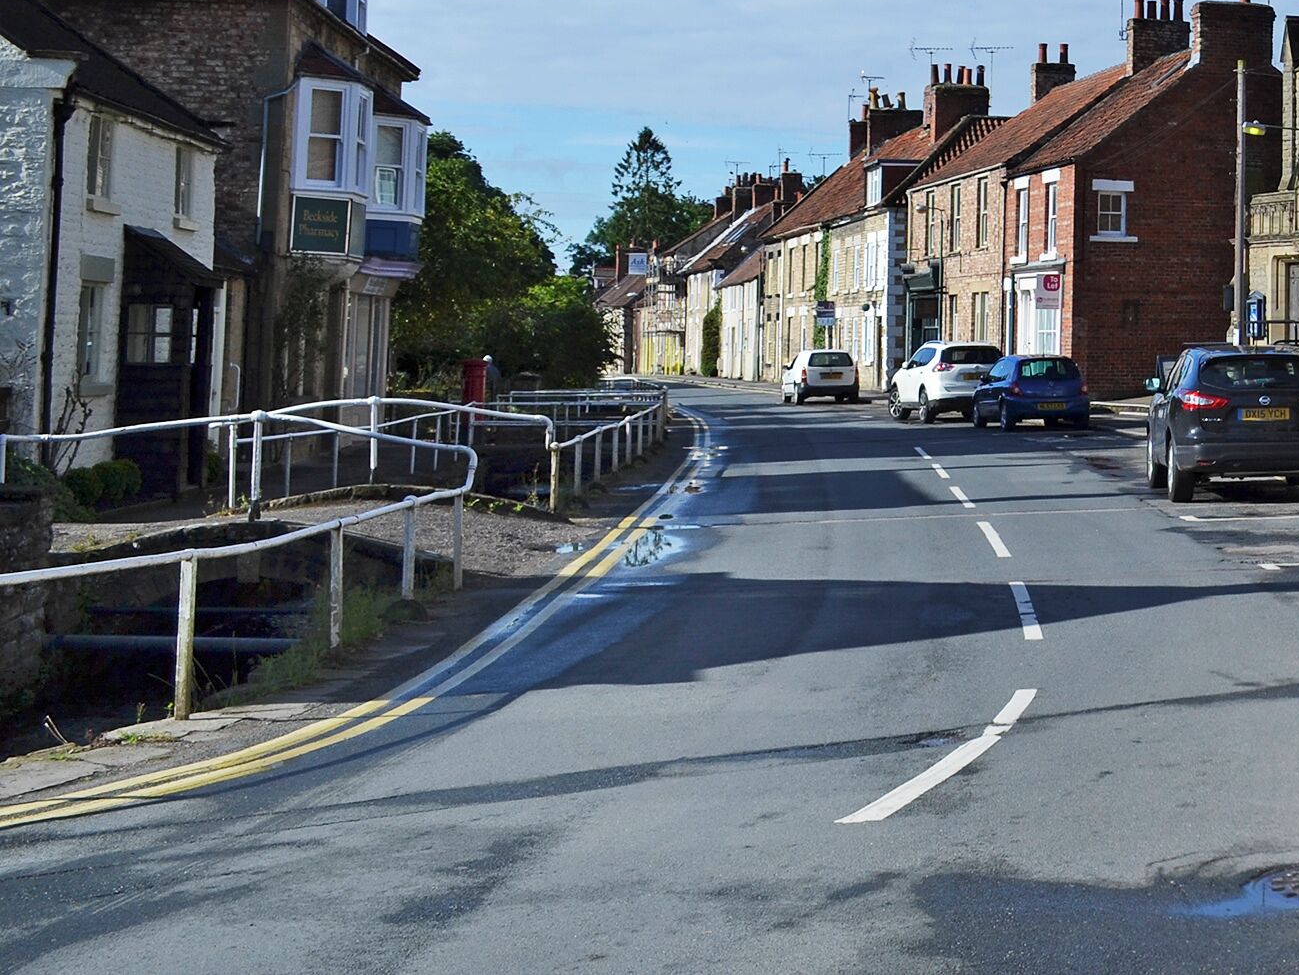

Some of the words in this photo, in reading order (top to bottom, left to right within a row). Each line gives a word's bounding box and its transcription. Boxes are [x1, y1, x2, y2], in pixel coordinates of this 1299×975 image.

[303, 210, 337, 223] Beckside
[299, 224, 339, 241] Pharmacy
[1245, 409, 1266, 418] DX15
[1268, 409, 1286, 418] YCH
